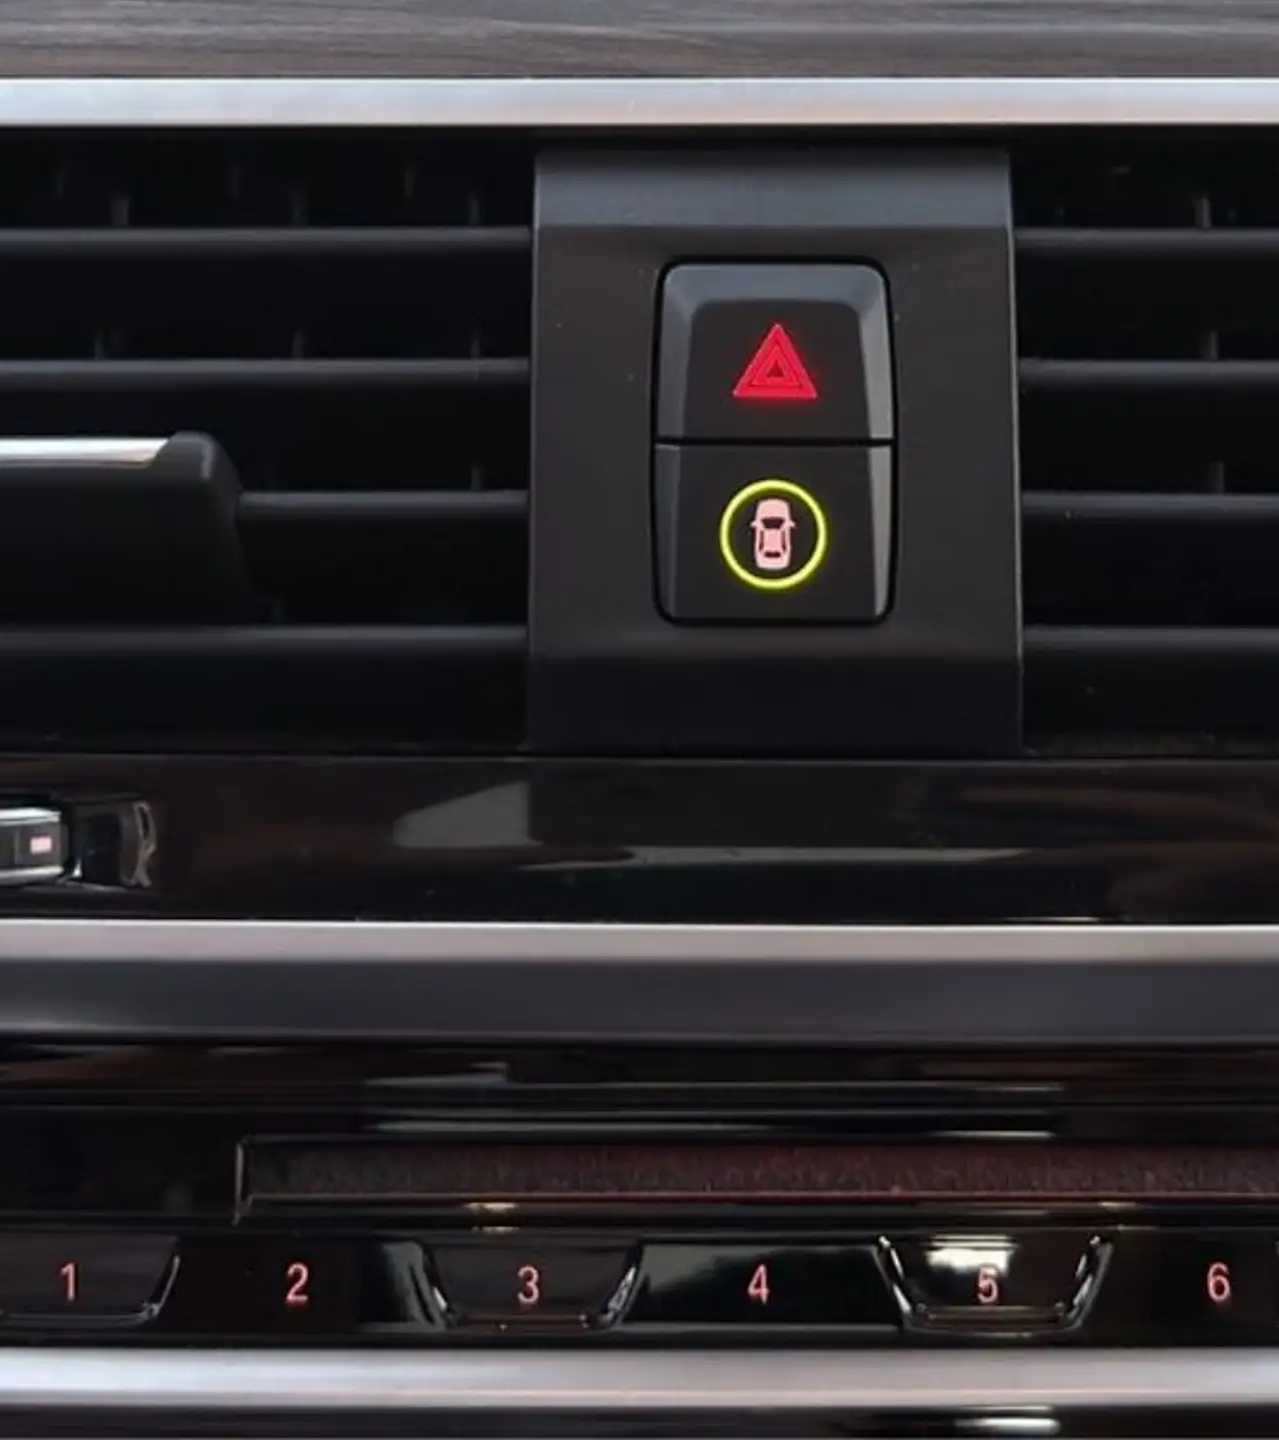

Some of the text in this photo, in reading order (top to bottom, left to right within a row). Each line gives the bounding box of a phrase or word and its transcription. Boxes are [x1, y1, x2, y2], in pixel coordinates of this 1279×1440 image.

[58, 1261, 78, 1303] 1
[285, 1262, 311, 1305] 2
[517, 1264, 542, 1305] 3
[745, 1262, 771, 1305] 4
[976, 1264, 1000, 1305] 5
[1207, 1261, 1232, 1303] 6
